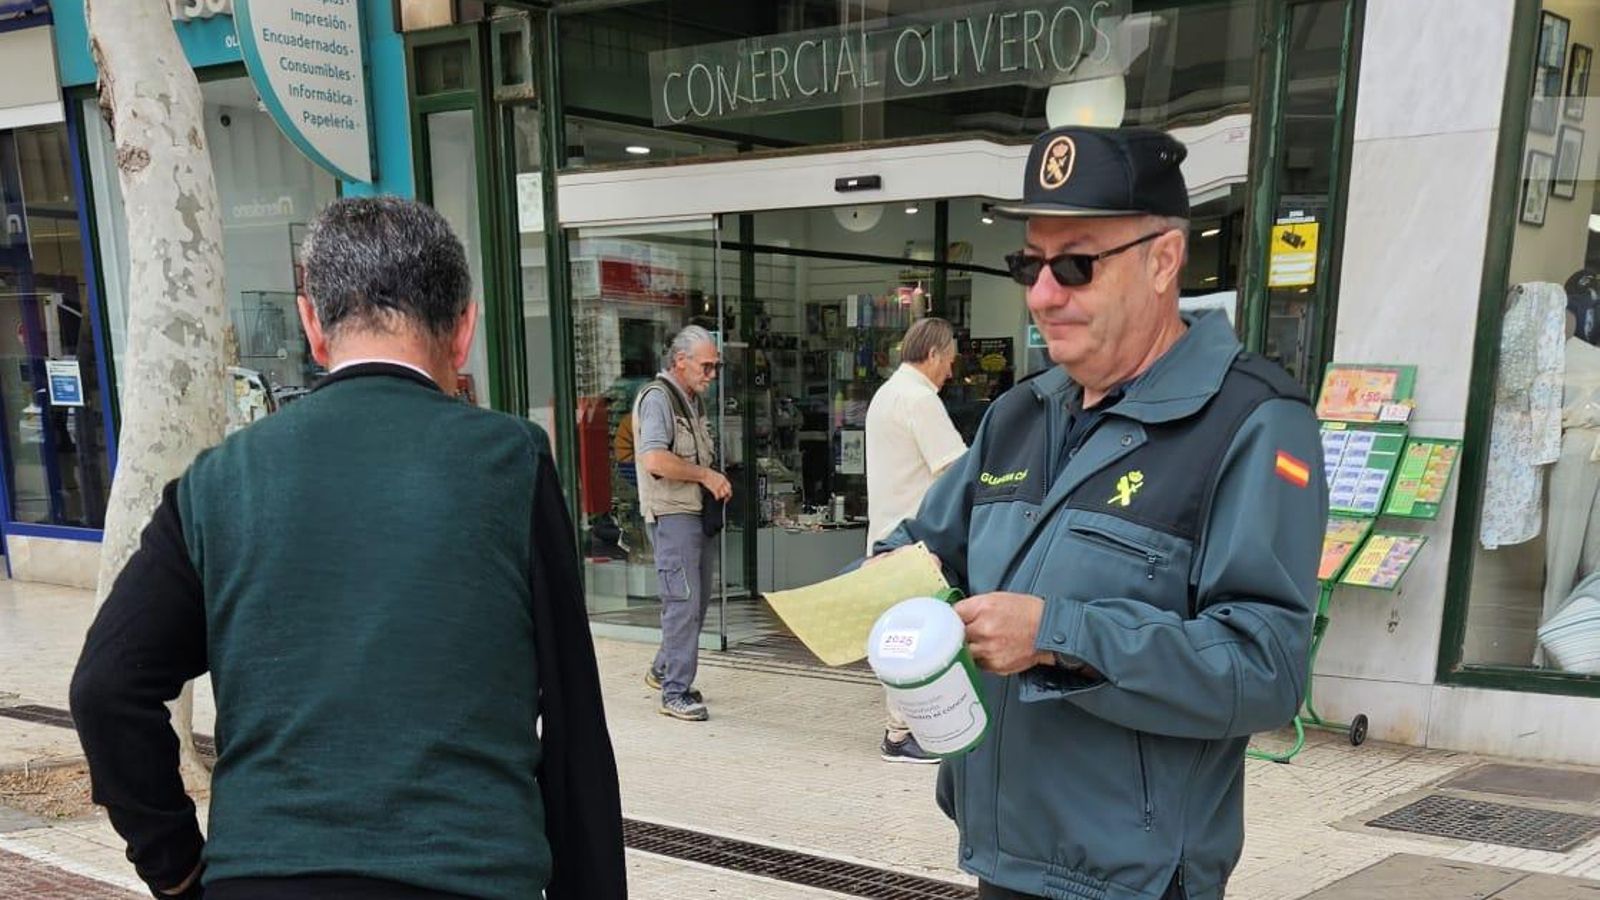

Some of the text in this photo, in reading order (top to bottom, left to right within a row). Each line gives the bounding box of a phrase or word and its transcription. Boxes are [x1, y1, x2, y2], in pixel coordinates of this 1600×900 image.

[290, 8, 346, 31] Impresión
[262, 28, 348, 56] Encuadernados
[279, 56, 351, 81] Consumibles
[663, 1, 1111, 123] COMERCIAL OLIVEROS
[288, 84, 353, 106] Informática
[302, 110, 354, 130] Papelería
